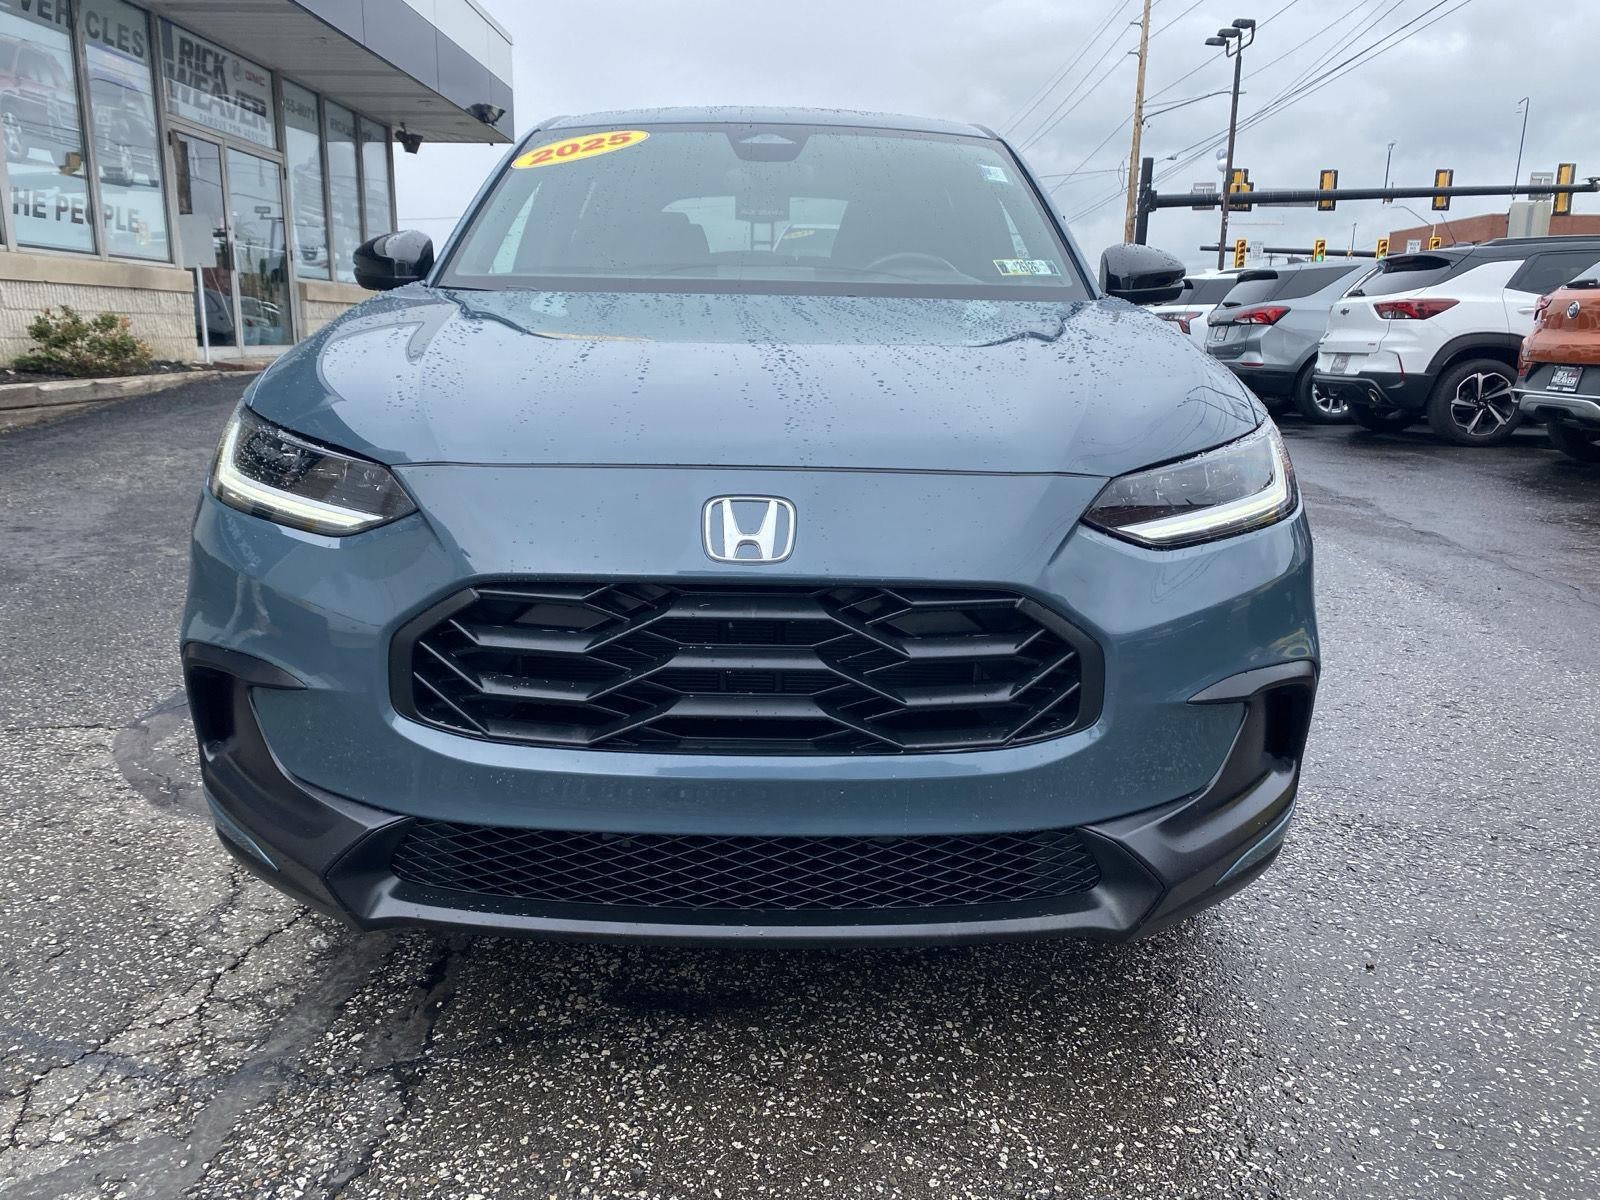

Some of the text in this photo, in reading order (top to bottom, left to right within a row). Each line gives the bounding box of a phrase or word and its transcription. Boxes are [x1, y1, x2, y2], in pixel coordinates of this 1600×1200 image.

[20, 0, 145, 59] EHCLES
[178, 37, 229, 95] RICK
[528, 132, 632, 166] 2025
[10, 187, 47, 219] HE
